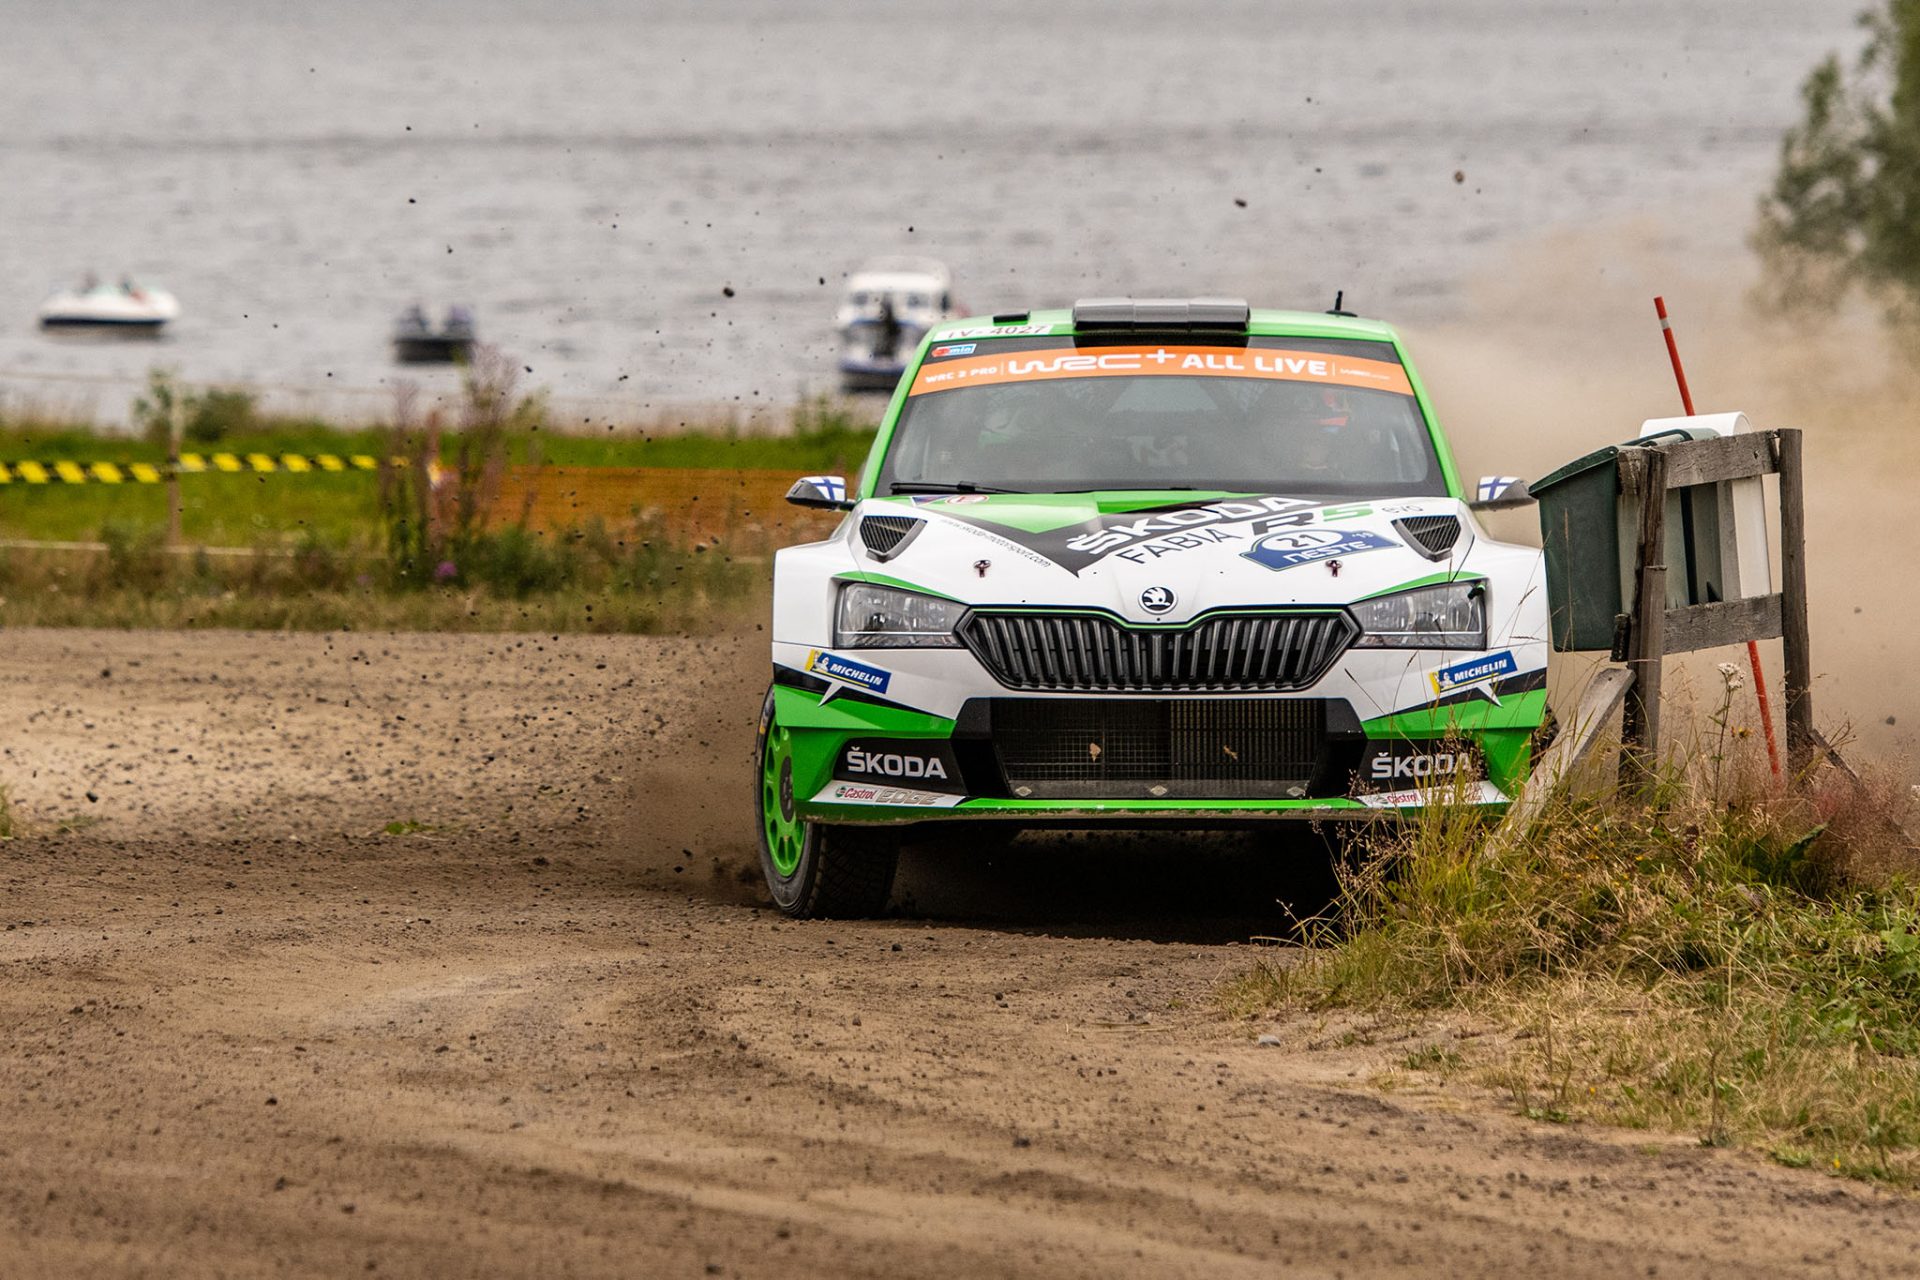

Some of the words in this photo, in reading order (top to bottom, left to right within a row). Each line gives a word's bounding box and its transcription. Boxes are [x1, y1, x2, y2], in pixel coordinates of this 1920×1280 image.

[925, 371, 955, 384] WRC
[958, 370, 967, 379] 2
[970, 366, 998, 377] PRO
[1181, 354, 1245, 370] ALL
[1254, 356, 1328, 376] LIVE
[1066, 496, 1322, 555] ŠKODA
[1115, 528, 1245, 564] FABIA
[1276, 533, 1326, 548] 21
[1282, 540, 1374, 563] NESTE
[830, 663, 884, 686] MICHELIN
[1454, 658, 1508, 682] MICHELIN
[846, 746, 948, 779] ŠKODA
[1371, 751, 1474, 779] ŠKODA
[843, 787, 878, 800] Castrol
[875, 787, 945, 806] EDGE
